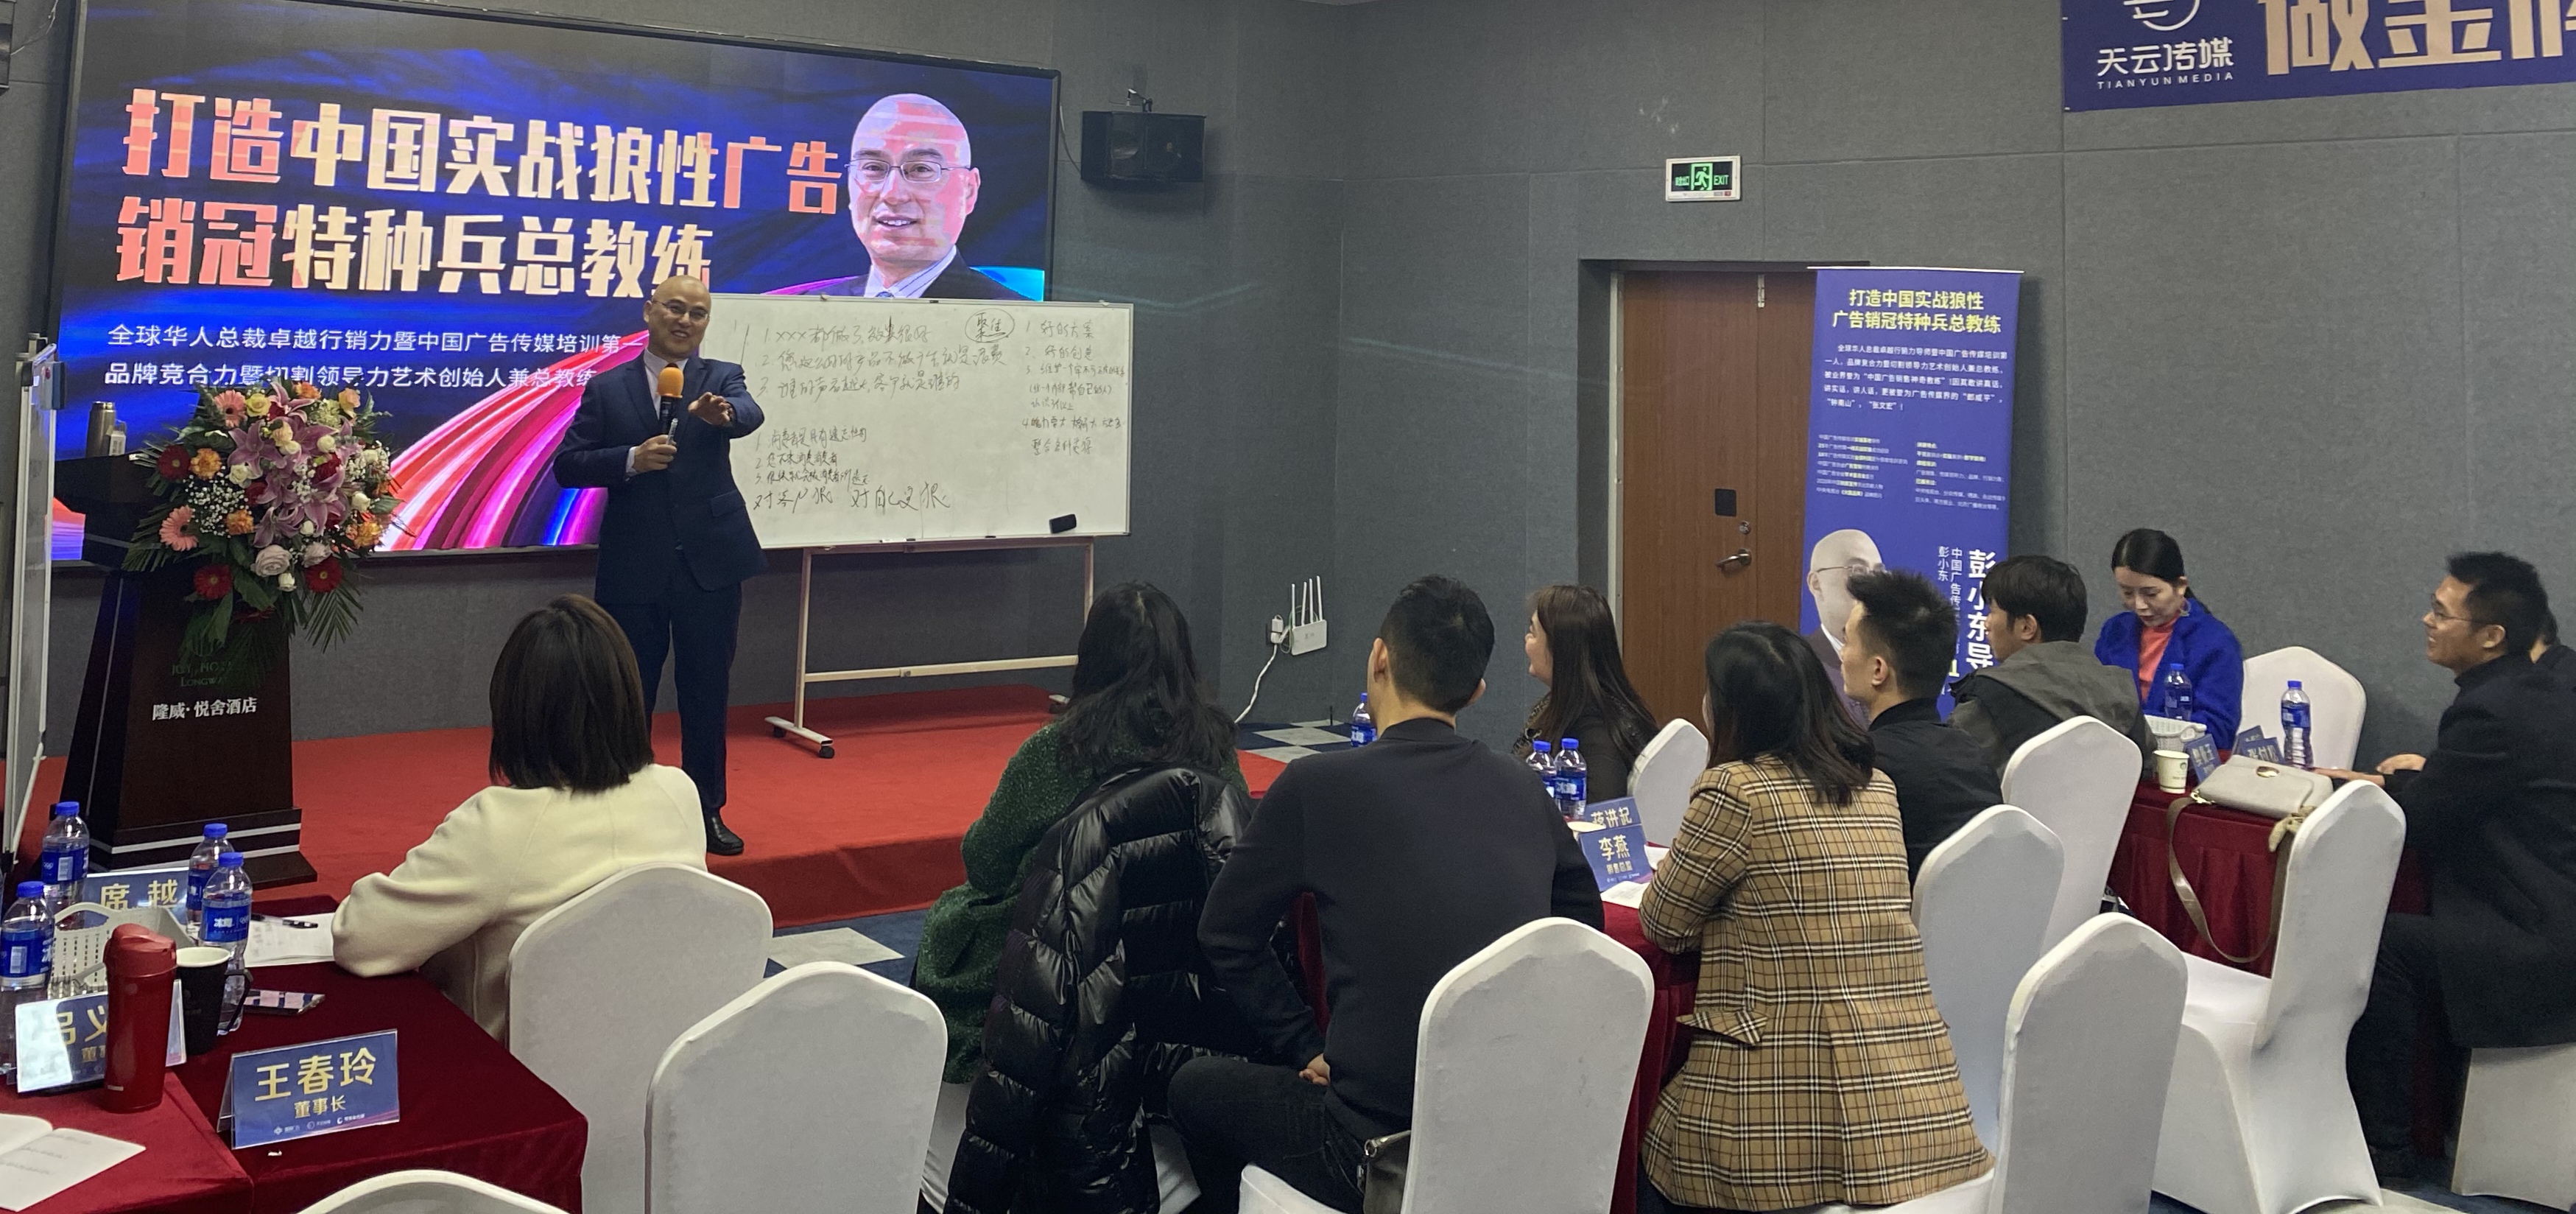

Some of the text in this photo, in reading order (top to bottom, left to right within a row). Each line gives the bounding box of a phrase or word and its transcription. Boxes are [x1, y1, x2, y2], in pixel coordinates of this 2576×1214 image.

[2097, 37, 2234, 77] 天云传媒
[2097, 71, 2234, 90] TIANYUN MEDIA
[121, 88, 842, 214] 打造中国实战狼性广告
[1714, 175, 1729, 185] EXIT
[116, 196, 714, 298] 销冠特种兵总教练
[1848, 288, 1985, 310] 打造中国实战狼性
[1831, 310, 2002, 334] 广告销冠特种兵总教练
[107, 323, 645, 354] 全球华人总裁卓越行销力暨中国广告传媒培训第一
[1938, 545, 1949, 582] 彭小东
[152, 696, 258, 721] 隆威·悦舍酒店
[1598, 834, 1630, 861] 李燕
[255, 1047, 377, 1102] 王春玲
[294, 1095, 346, 1119] 董事长
